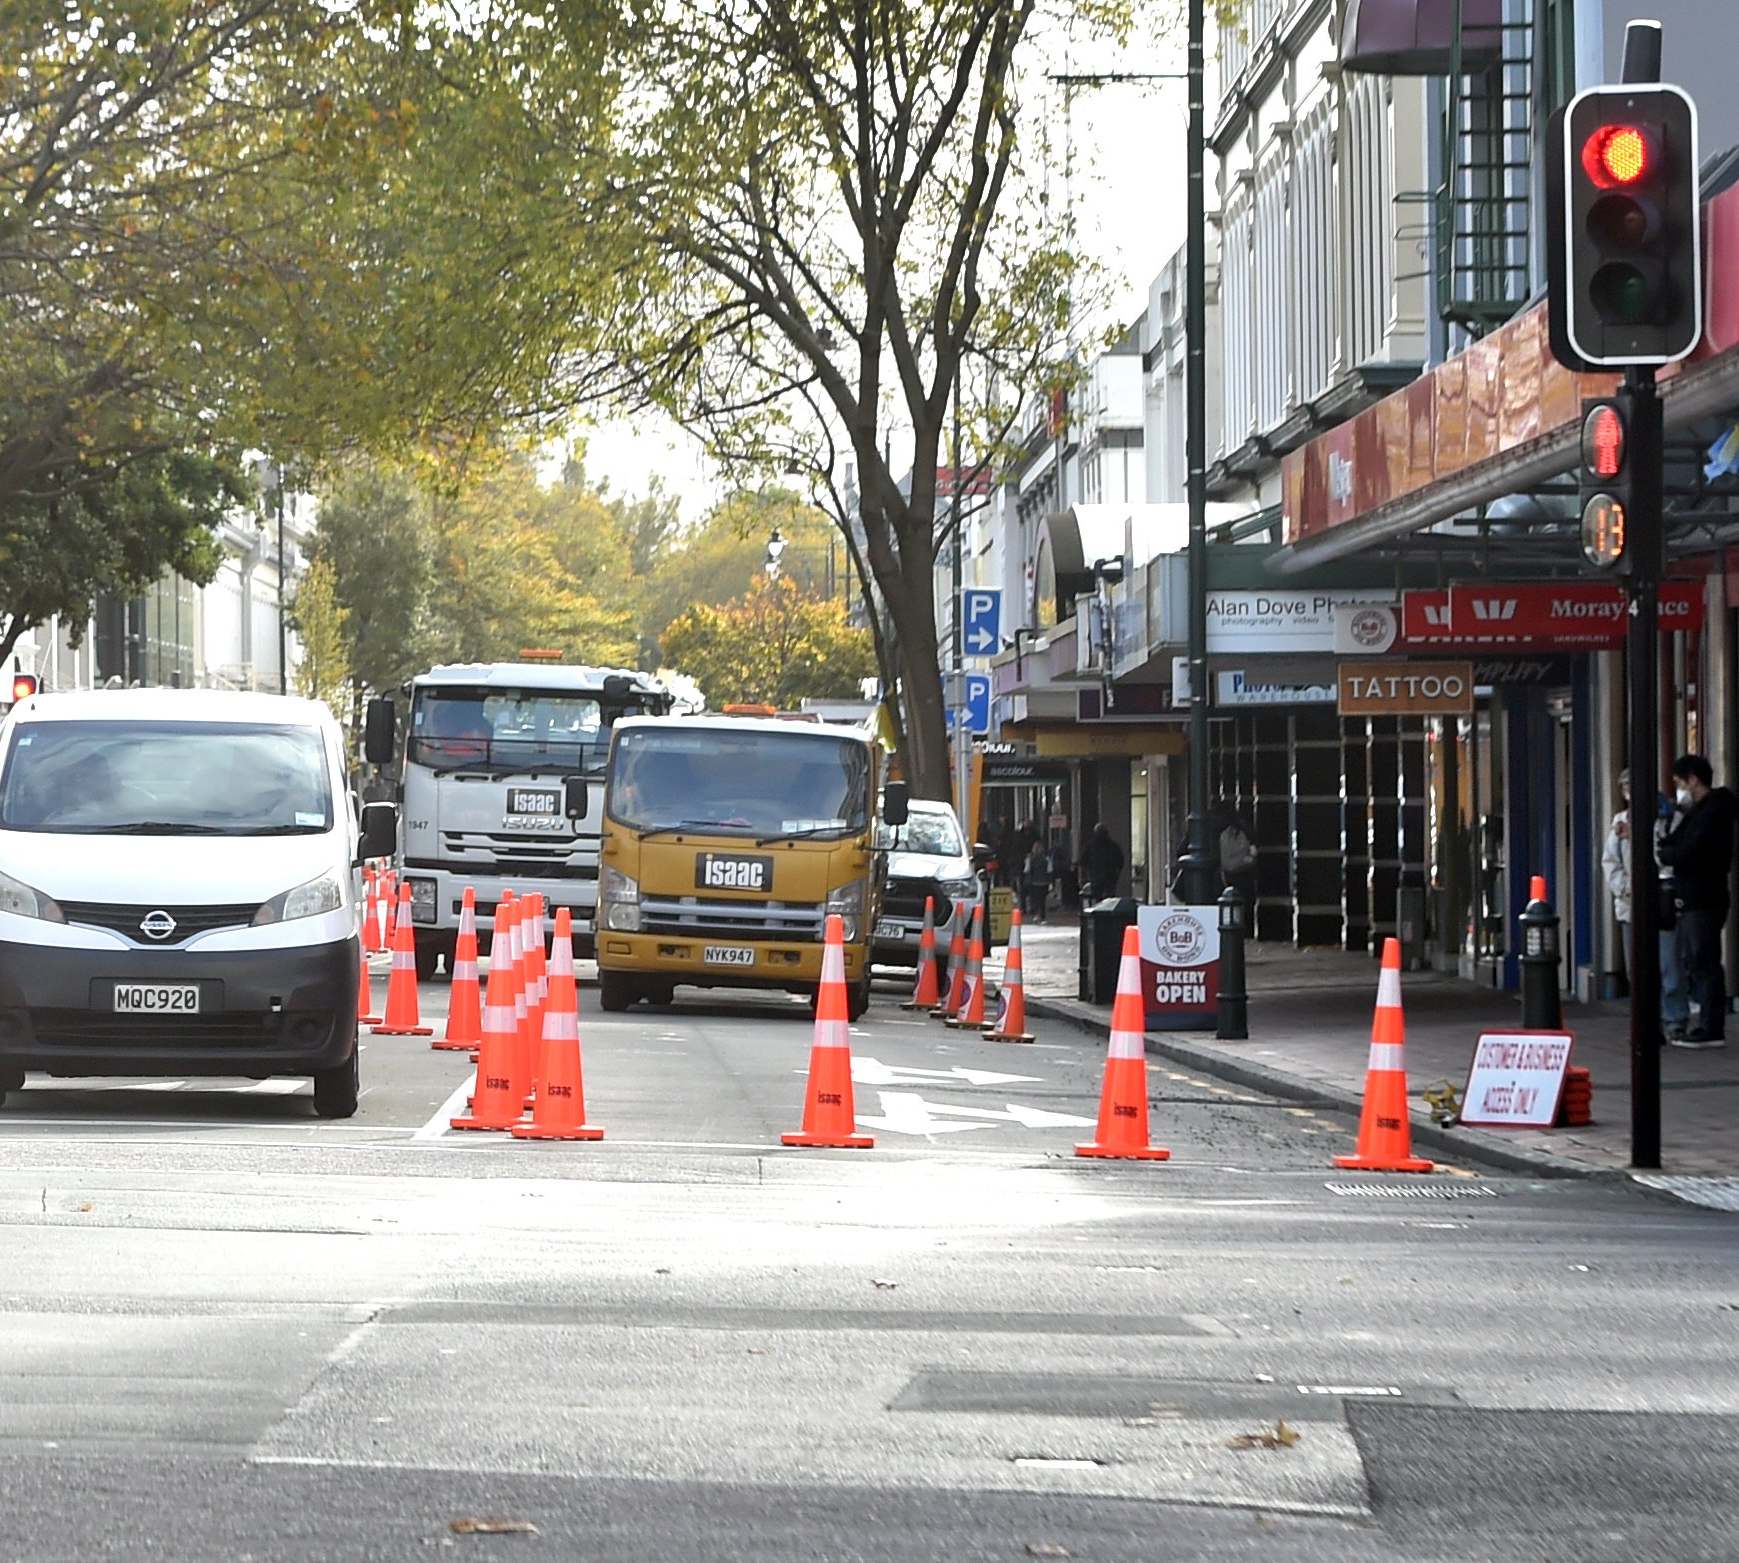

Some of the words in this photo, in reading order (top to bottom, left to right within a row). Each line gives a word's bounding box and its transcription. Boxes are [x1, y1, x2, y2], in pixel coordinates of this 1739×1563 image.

[970, 594, 993, 624] P
[1206, 598, 1249, 616] Alan
[1257, 598, 1306, 616] Dove
[1551, 600, 1624, 621] Moray
[1628, 599, 1639, 617] 4
[1475, 660, 1553, 682] MPLIFY
[969, 682, 985, 701] P
[1347, 676, 1463, 699] TATTOO
[513, 789, 555, 813] isaac
[502, 816, 564, 831] ISUZU
[704, 854, 764, 888] isaac
[706, 946, 753, 964] NYK947
[1156, 971, 1206, 984] BAKERY
[117, 988, 196, 1010] MQC920
[1156, 985, 1206, 1003] OPEN
